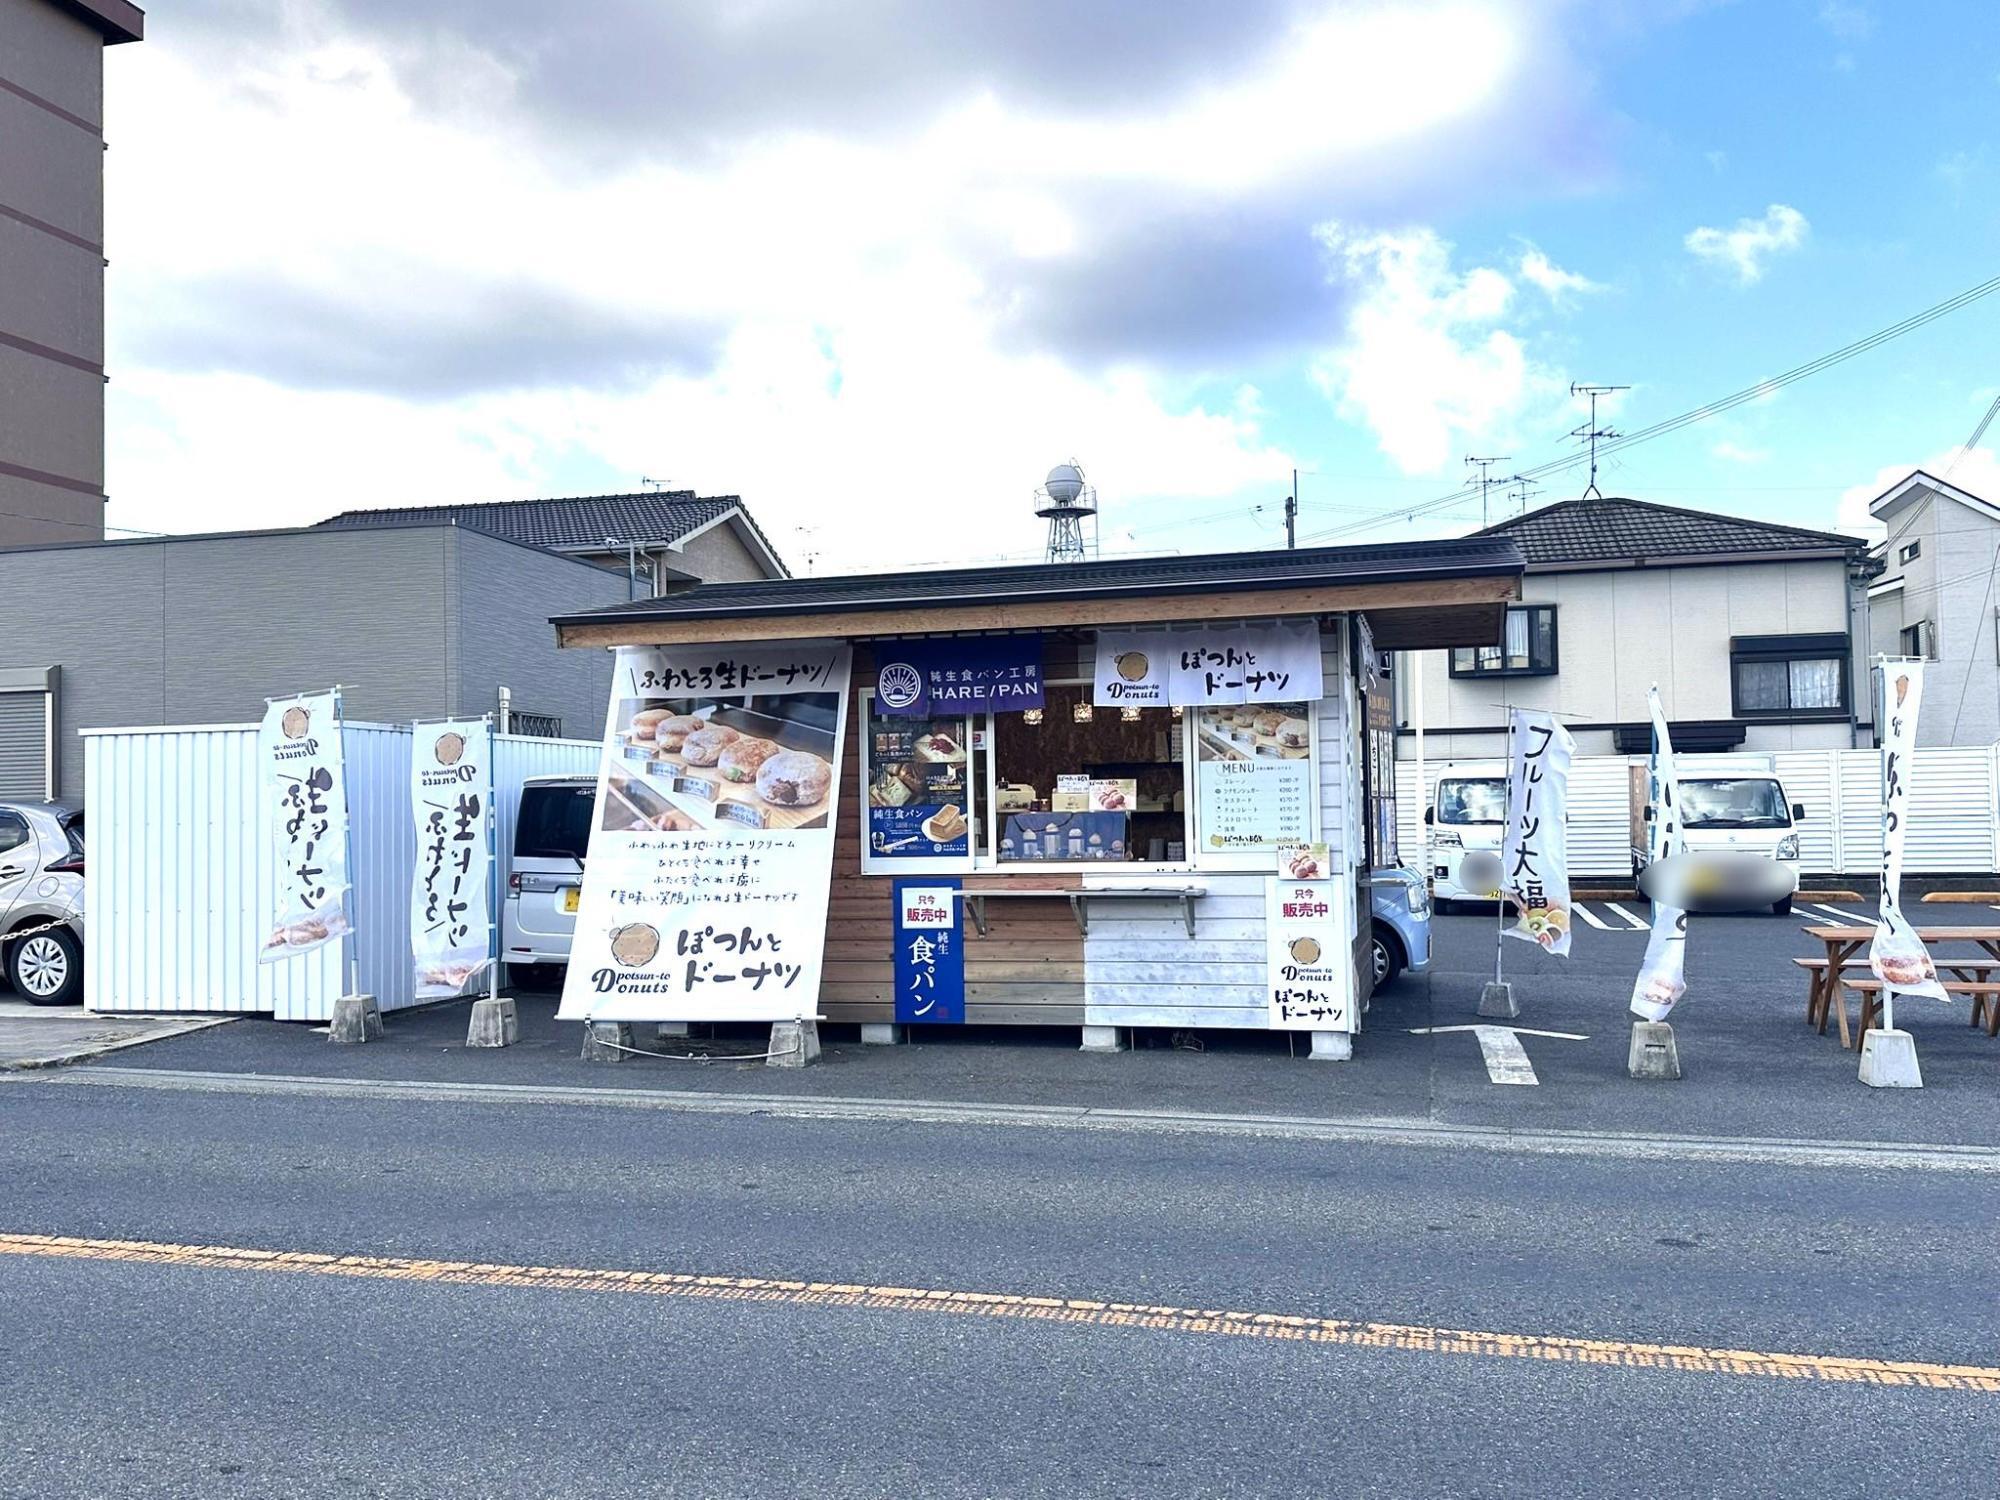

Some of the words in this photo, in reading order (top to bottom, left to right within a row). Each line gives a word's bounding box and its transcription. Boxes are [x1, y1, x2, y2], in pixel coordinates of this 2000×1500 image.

[1181, 648, 1256, 670] ぽつんと
[640, 660, 823, 690] ふわとろ生ドーナツ
[930, 665, 1037, 682] 純生食パン工房
[931, 682, 1039, 700] HARE/PAN
[1106, 682, 1160, 699] Donuts
[1205, 672, 1290, 696] ドーナツ
[1222, 763, 1255, 773] MENU
[873, 808, 923, 820] 純生食パン
[1511, 725, 1553, 910] フルーツ大福
[917, 895, 936, 905] 只今
[1294, 888, 1314, 899] 只今
[907, 908, 947, 922] 販売中
[1282, 902, 1329, 918] 販売中
[677, 926, 782, 955] ぽつんと
[937, 931, 949, 955] 純生
[591, 968, 669, 993] Donuts
[616, 971, 671, 985] potsun-to
[685, 960, 801, 992] ドーナツ
[908, 935, 936, 1016] 食パン
[1281, 965, 1333, 982] Donuts
[1275, 989, 1329, 1004] ぽつんと
[1282, 1005, 1343, 1021] ドーナツ
